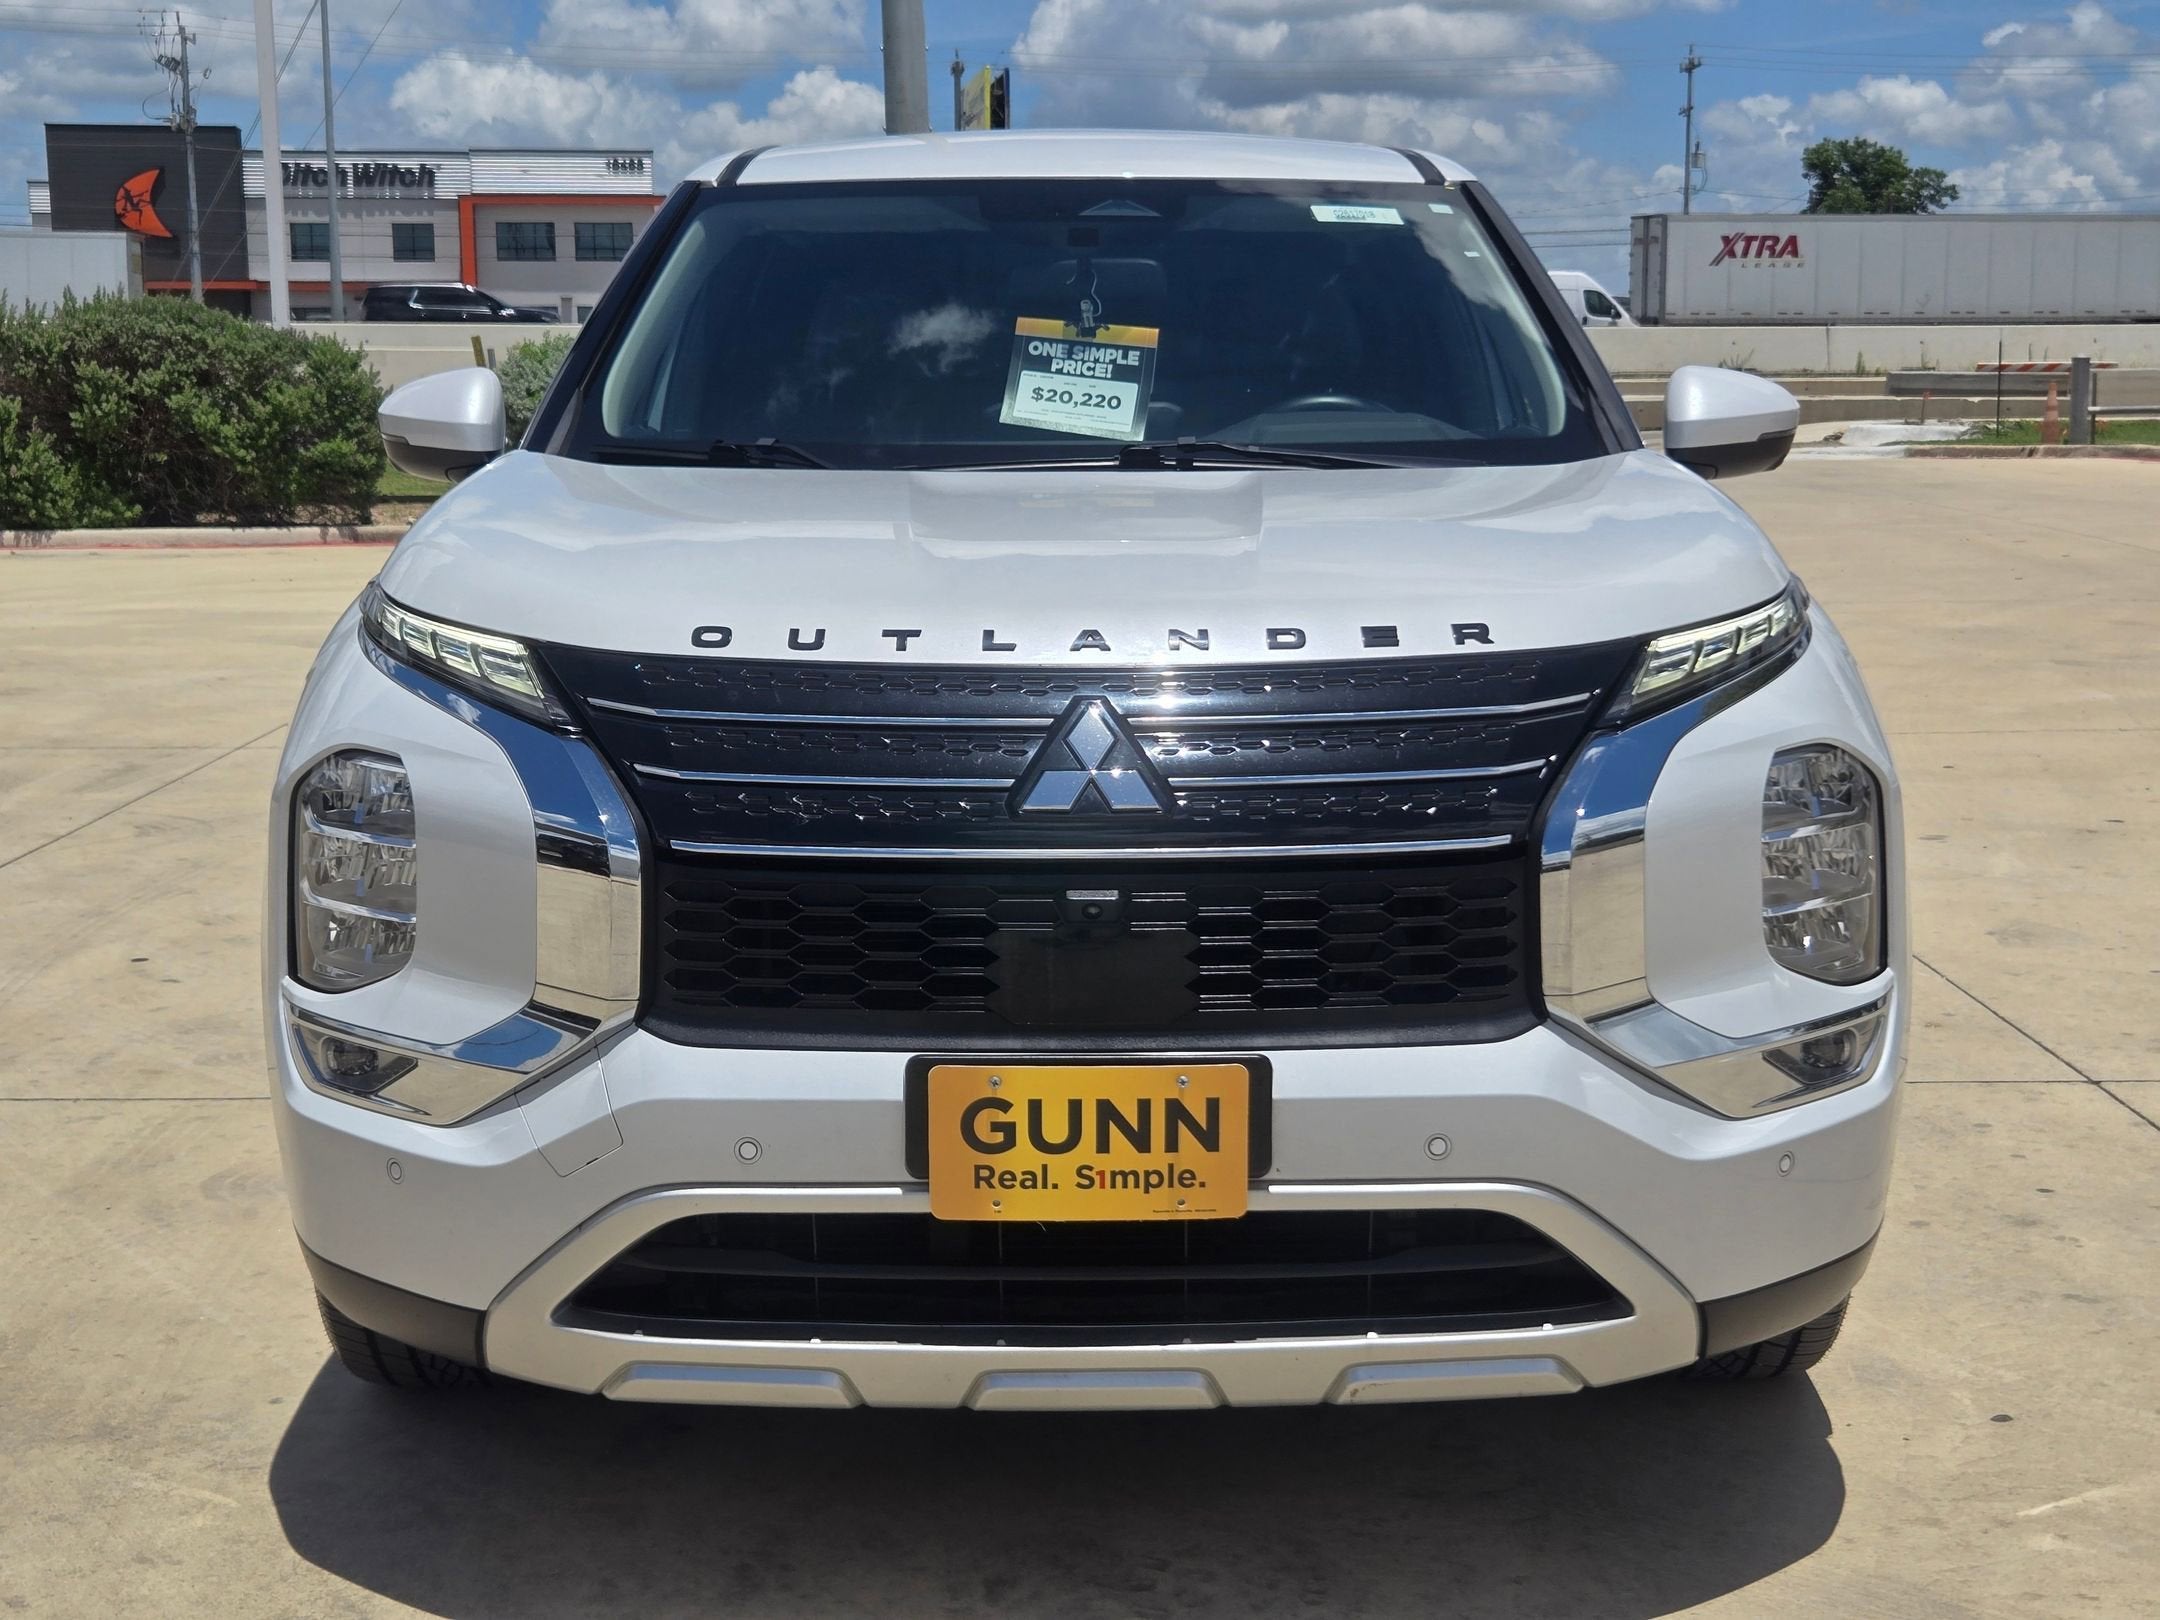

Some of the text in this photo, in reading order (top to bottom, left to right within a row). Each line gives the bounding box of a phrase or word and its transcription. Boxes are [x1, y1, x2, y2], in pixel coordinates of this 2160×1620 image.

[352, 163, 436, 188] Witch
[1709, 232, 1799, 266] XTRA
[1028, 341, 1140, 366] ONE SIMPLE
[1051, 358, 1113, 378] PRICE!
[1031, 386, 1122, 410] $20,220
[691, 622, 1494, 651] OUTLANDER
[960, 1096, 1220, 1155] GUNN
[974, 1163, 1206, 1194] Real. S1mple.
